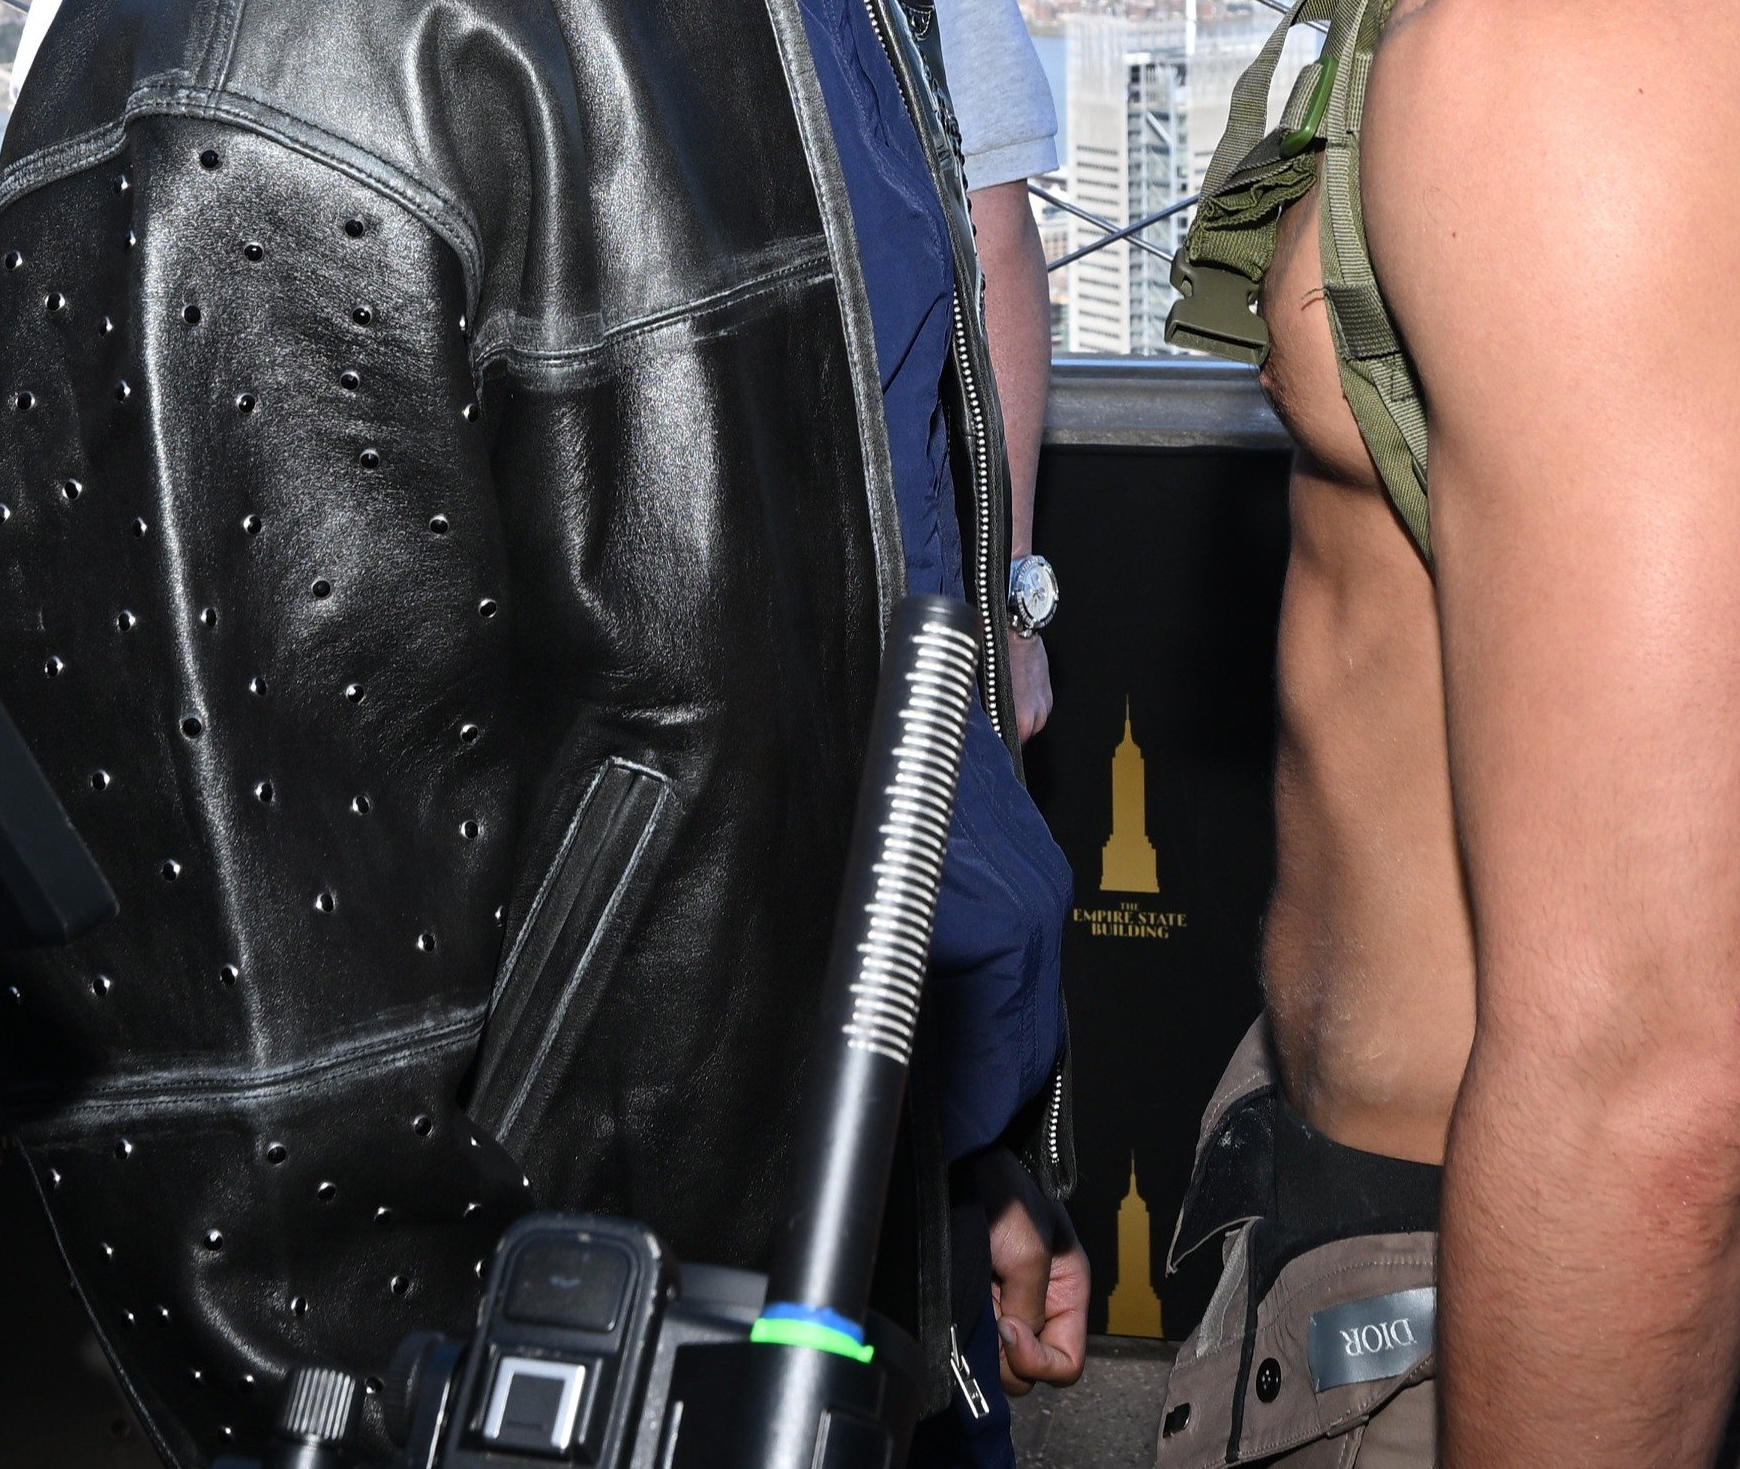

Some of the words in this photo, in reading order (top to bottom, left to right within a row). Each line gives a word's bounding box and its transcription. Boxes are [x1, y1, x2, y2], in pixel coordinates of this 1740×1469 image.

[1120, 902, 1140, 911] THE
[1073, 908, 1134, 924] EMPIRE
[1138, 912, 1187, 927] STATE
[1091, 922, 1169, 939] BUILDING
[1339, 1318, 1418, 1357] DIOR
